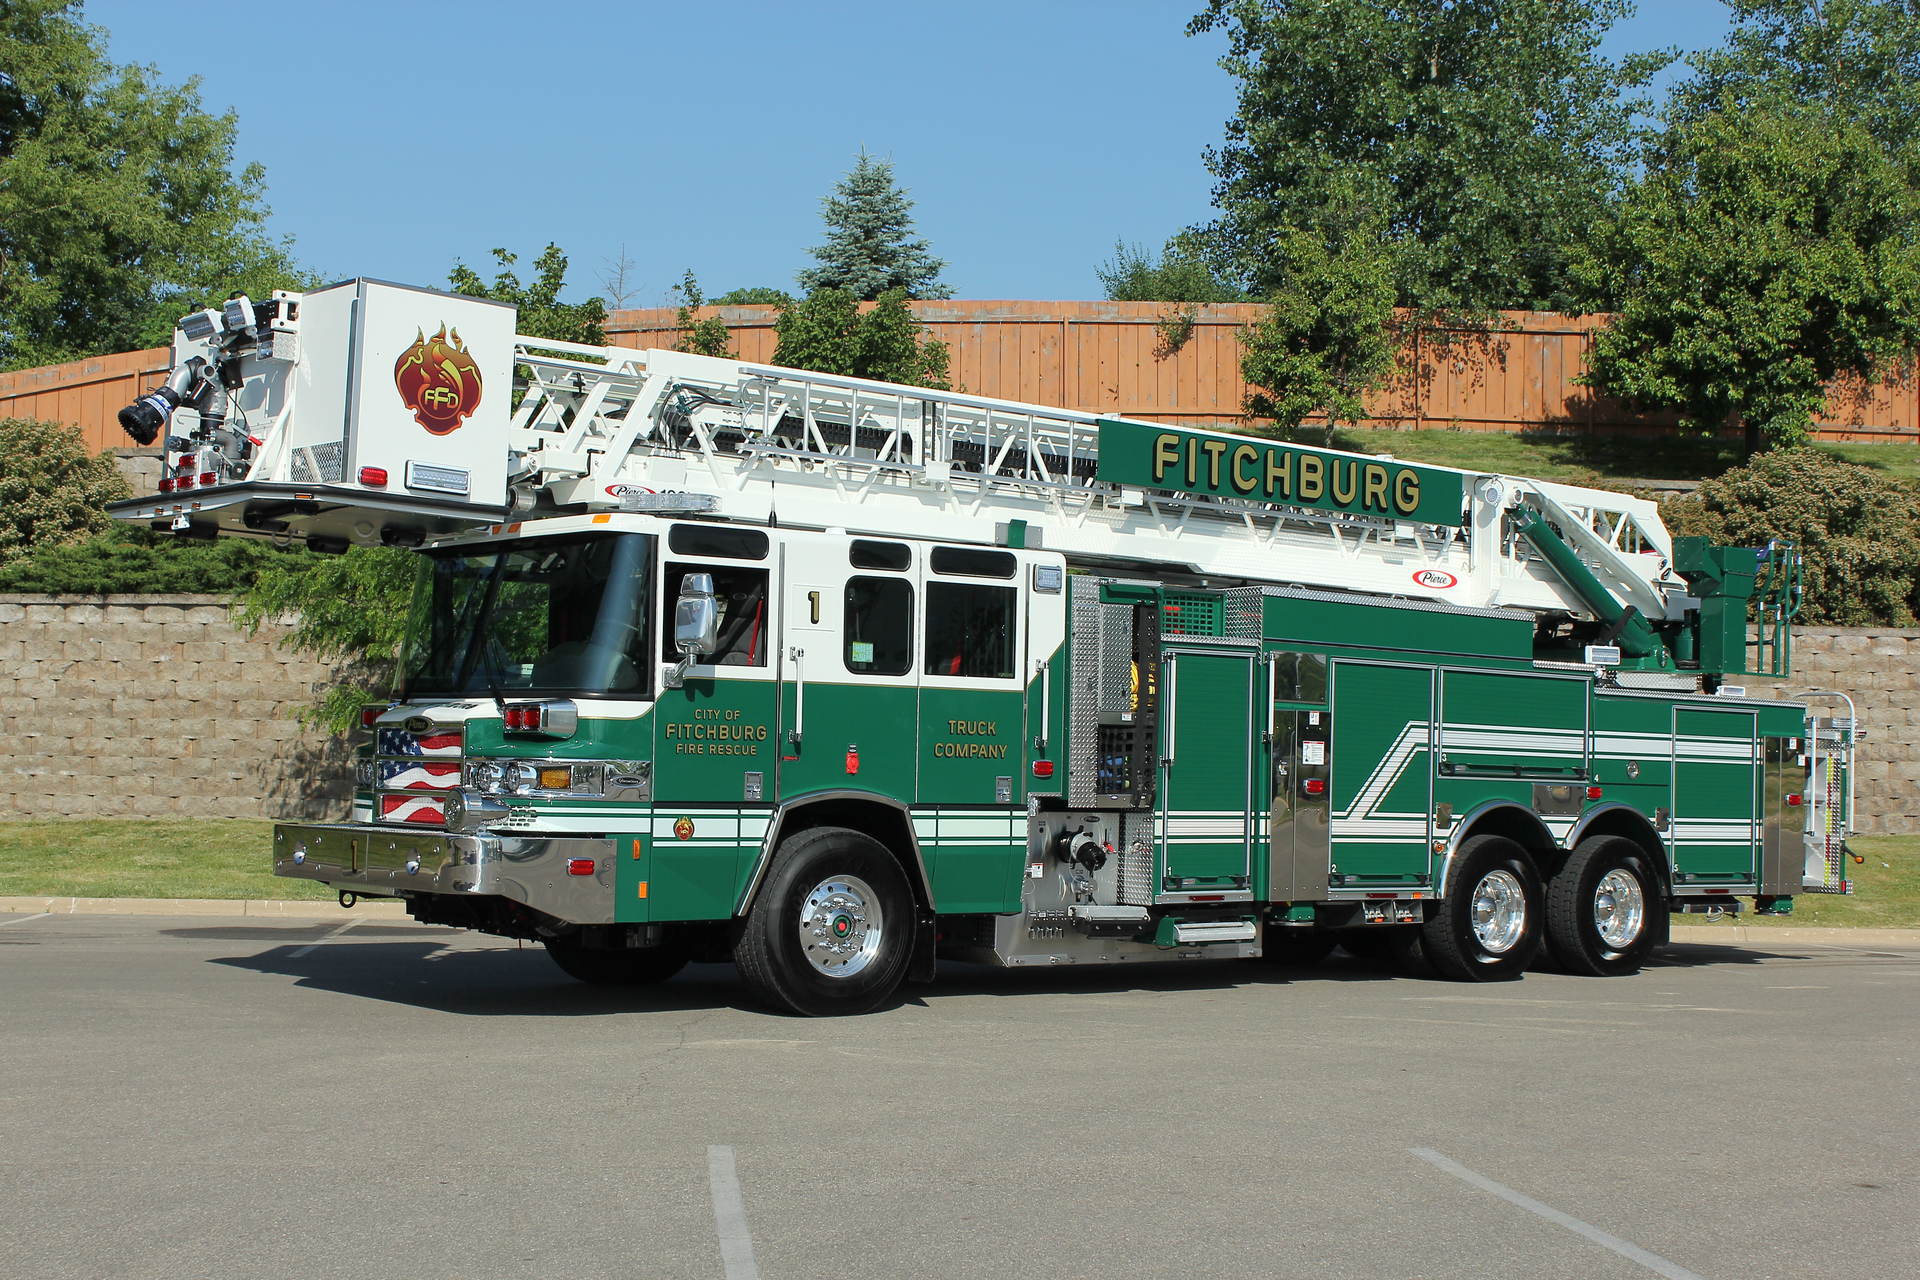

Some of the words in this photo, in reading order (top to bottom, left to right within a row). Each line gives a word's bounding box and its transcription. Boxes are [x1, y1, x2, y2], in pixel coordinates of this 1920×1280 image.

[424, 386, 459, 410] FFD
[1152, 433, 1420, 516] FITCHBURG
[1422, 571, 1447, 584] Pierce
[808, 591, 819, 624] 1
[694, 709, 720, 720] CITY
[725, 710, 740, 721] OF
[666, 723, 767, 741] FITCHBURG
[948, 720, 996, 736] TRUCK
[676, 743, 703, 755] FIRE
[709, 744, 757, 756] RESCUE
[934, 742, 1008, 759] COMPANY
[1441, 753, 1447, 762] 3
[1594, 774, 1599, 783] 4
[351, 839, 358, 873] 1
[1167, 866, 1172, 876] 1
[1331, 863, 1337, 873] 2
[1673, 863, 1679, 872] 5
